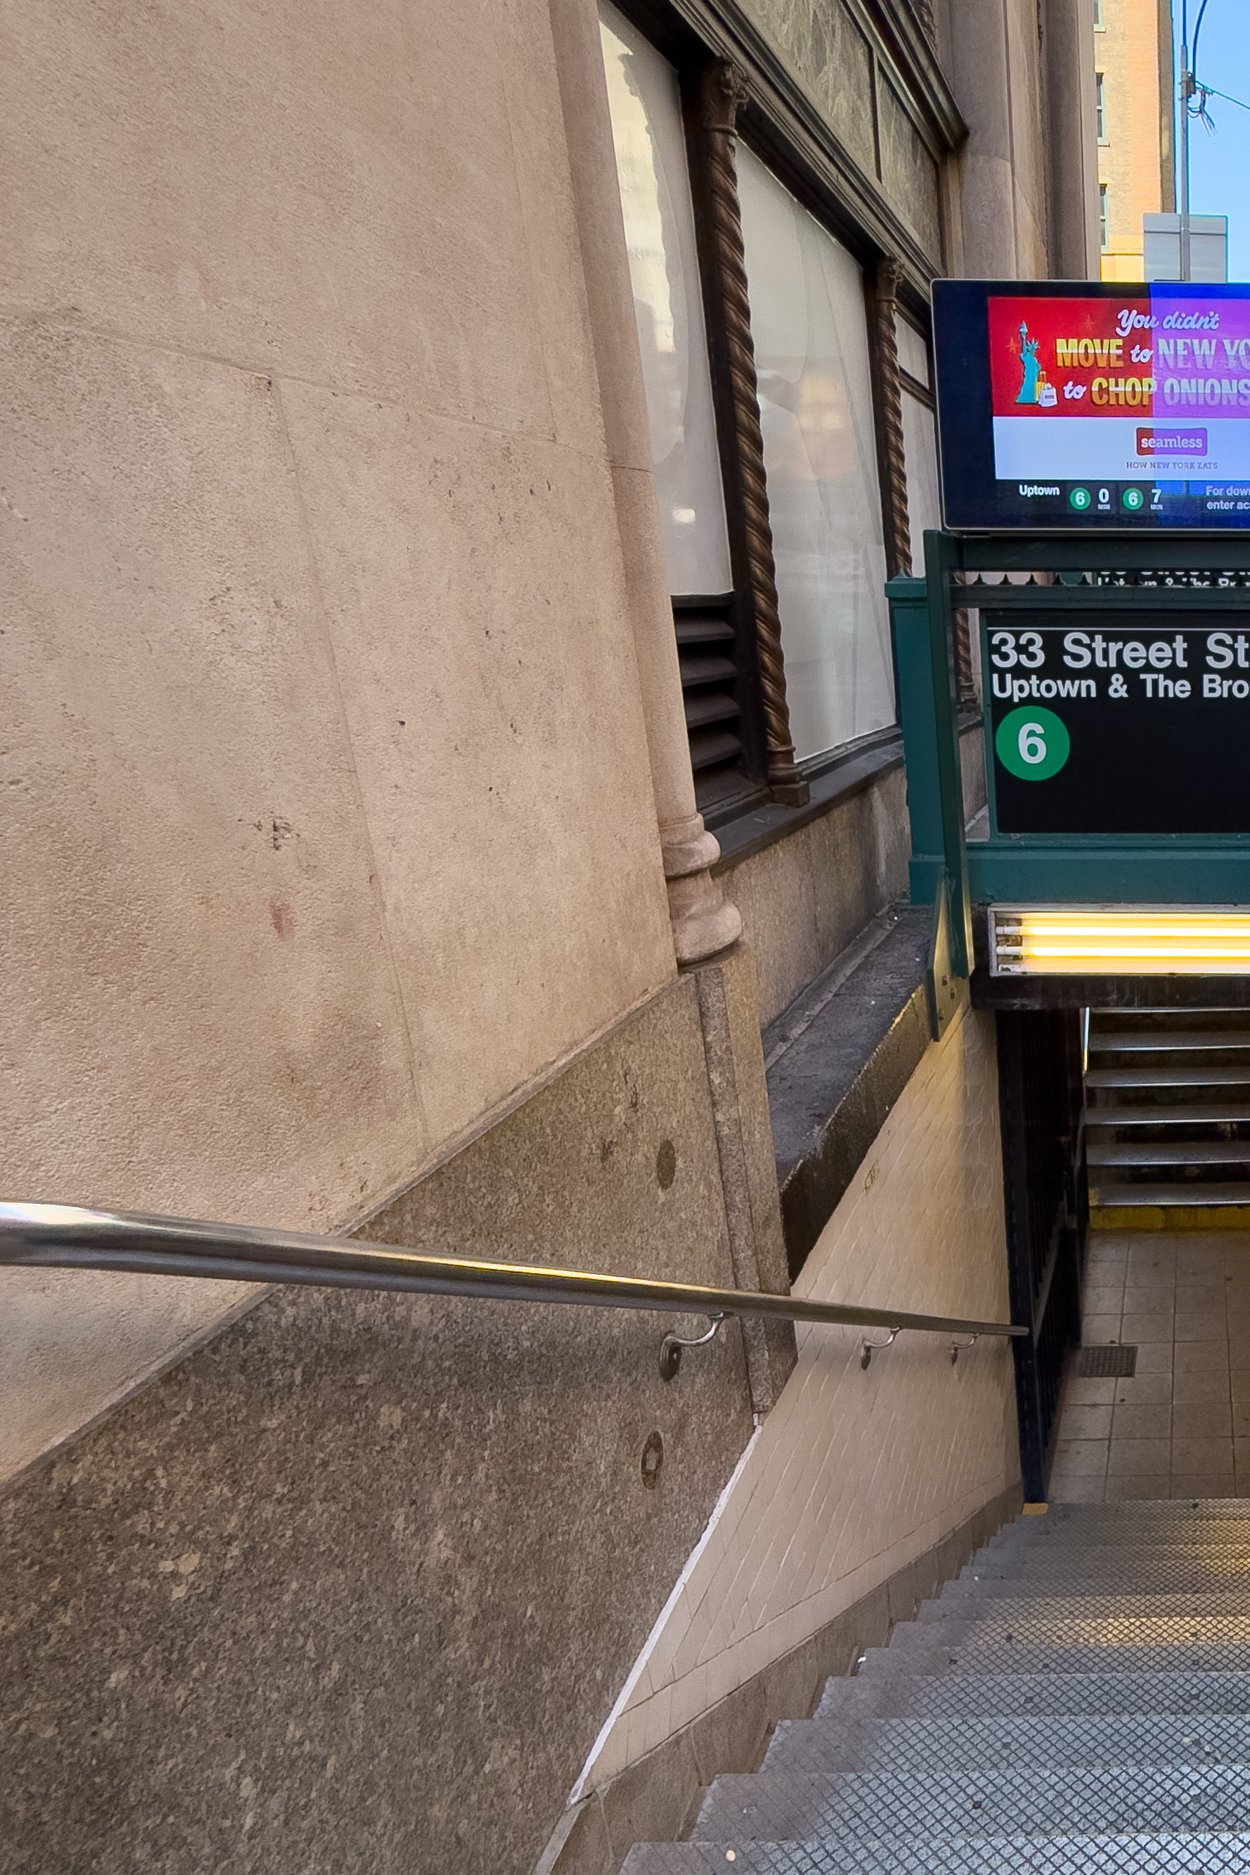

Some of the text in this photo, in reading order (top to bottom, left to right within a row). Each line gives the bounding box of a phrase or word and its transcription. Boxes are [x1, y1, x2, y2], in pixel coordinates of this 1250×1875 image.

[1115, 309, 1219, 337] You didn't
[1056, 338, 1125, 369] MOVE
[1130, 343, 1153, 364] to
[1157, 338, 1217, 369] NEW
[1063, 380, 1087, 400] to
[1091, 377, 1157, 406] CHOP
[1141, 435, 1203, 448] seamless
[1197, 462, 1218, 470] EATS
[1019, 485, 1060, 497] Uptown
[1075, 488, 1162, 505] 6 0 6 7
[1206, 486, 1224, 496] For
[1206, 501, 1235, 510] enter
[991, 631, 1046, 669] 33
[1062, 631, 1189, 669] Street
[992, 673, 1097, 702] Uptown
[1108, 673, 1129, 699] &
[1140, 673, 1191, 699] The
[1017, 722, 1048, 765] 6
